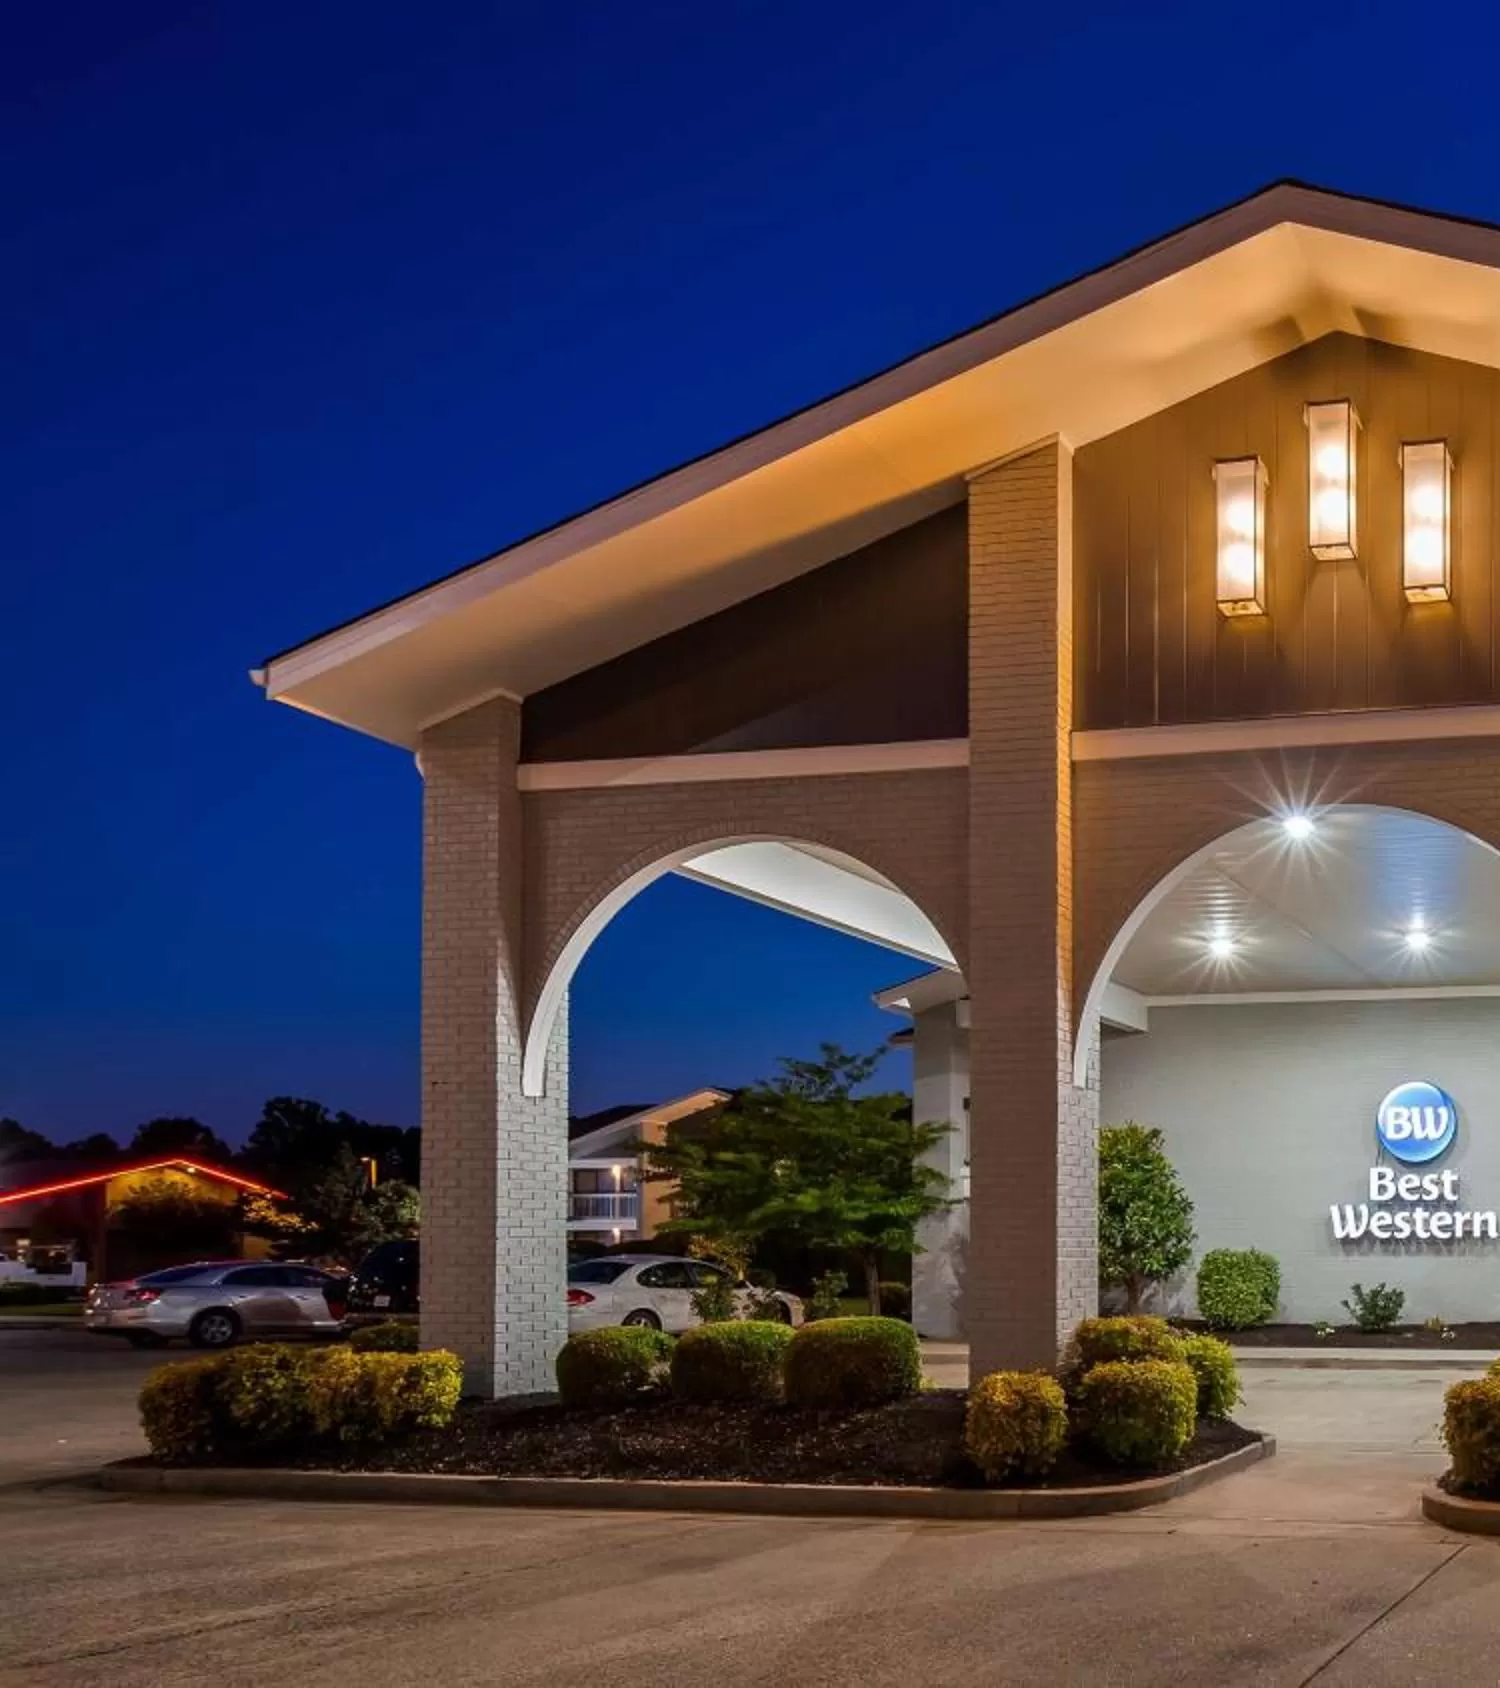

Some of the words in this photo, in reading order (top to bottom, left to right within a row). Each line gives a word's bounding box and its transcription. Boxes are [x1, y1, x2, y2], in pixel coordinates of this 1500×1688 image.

[1384, 1105, 1448, 1140] BW
[1368, 1167, 1459, 1202] Best
[1329, 1204, 1499, 1240] Western
